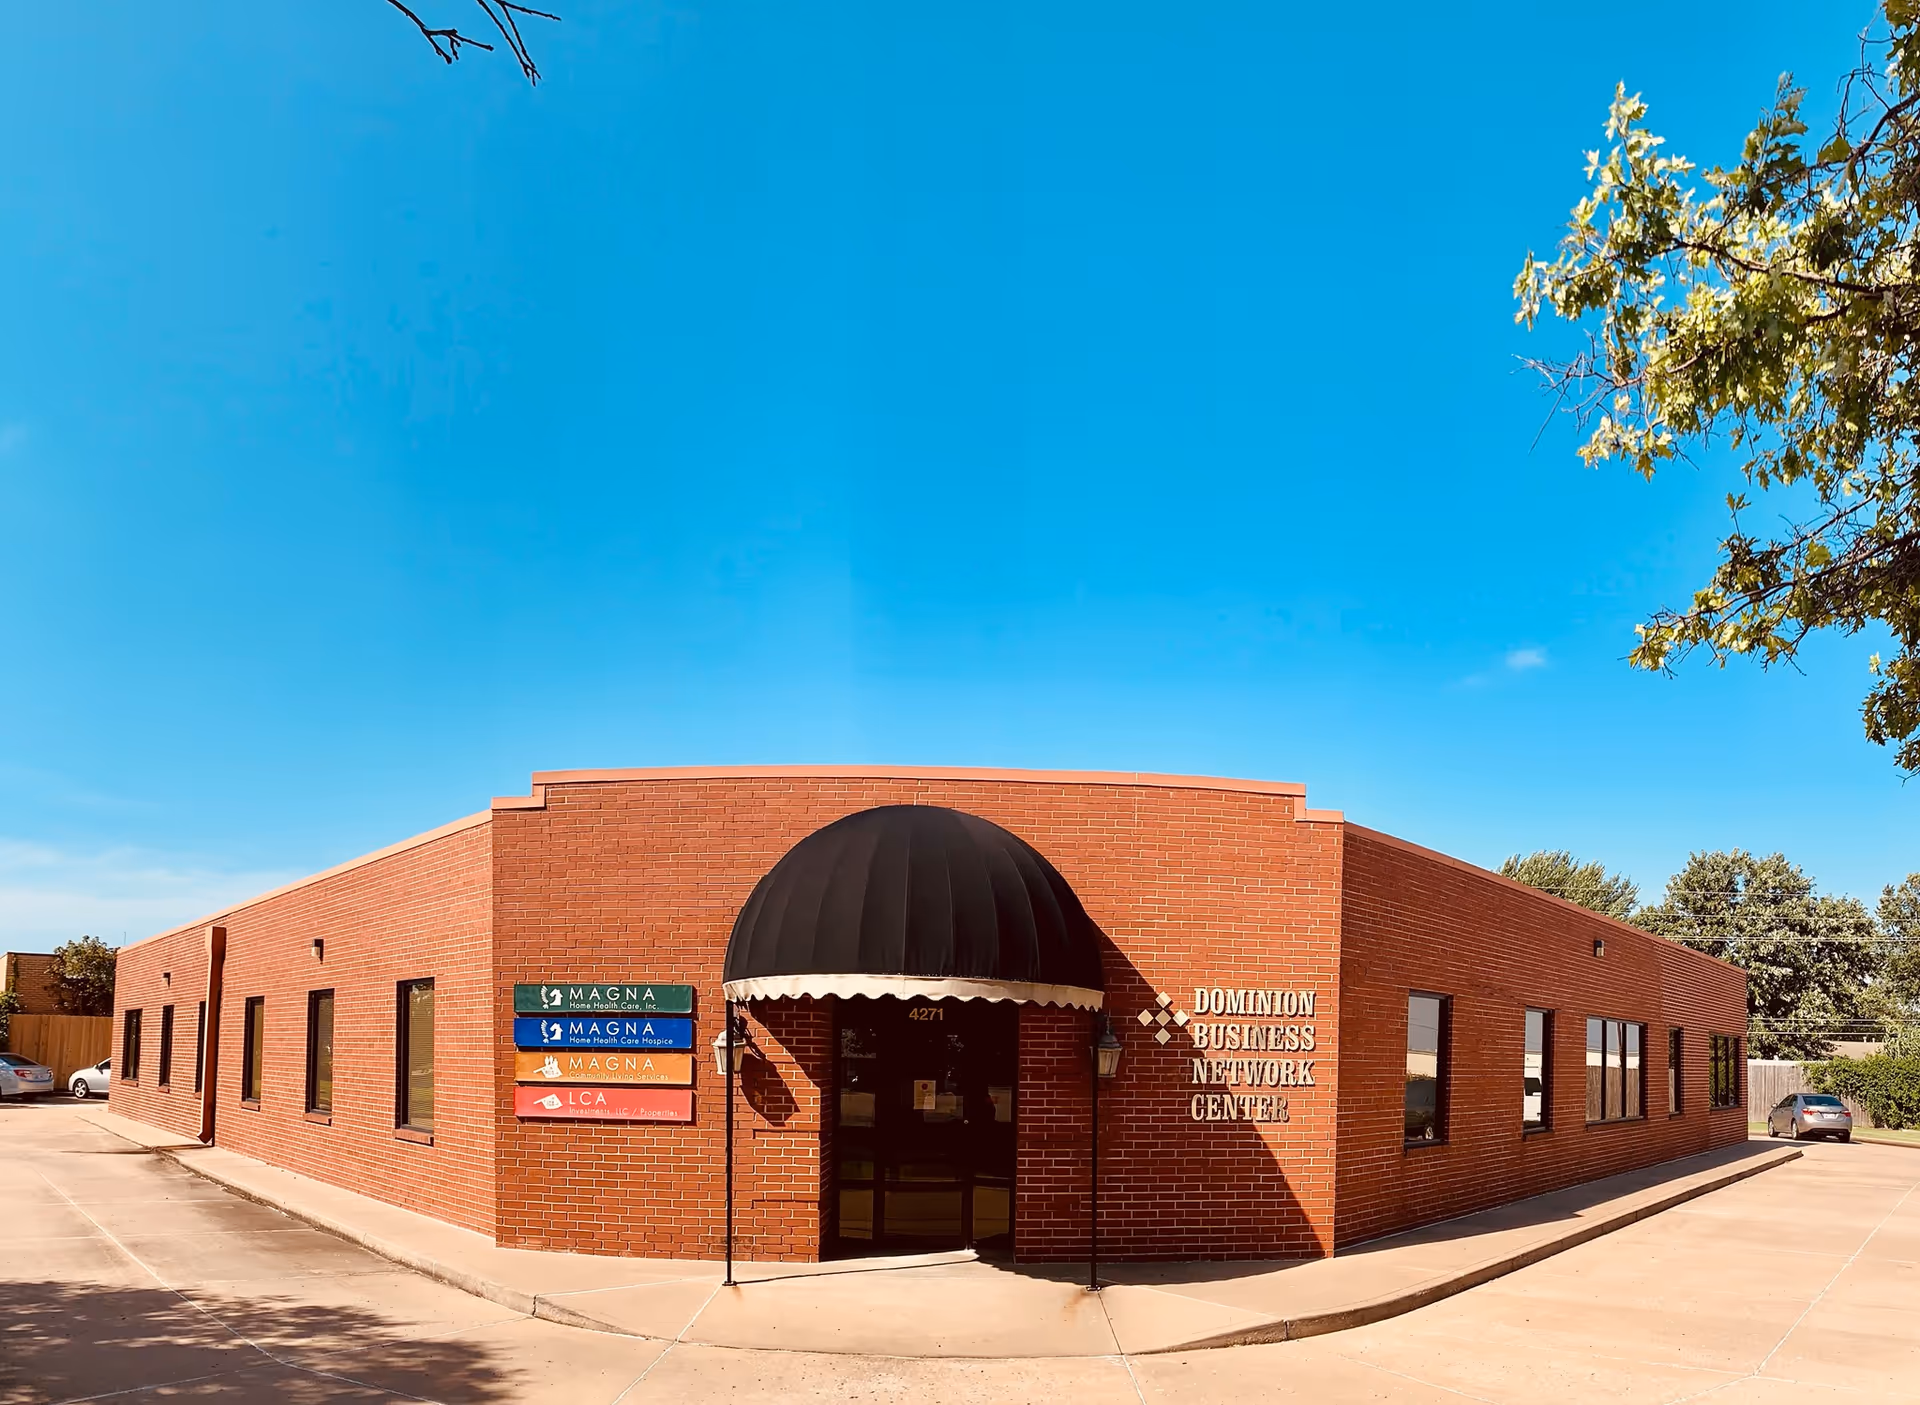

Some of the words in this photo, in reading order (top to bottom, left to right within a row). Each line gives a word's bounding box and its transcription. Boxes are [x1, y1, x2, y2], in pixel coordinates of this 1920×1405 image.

[569, 987, 655, 1001] MAGNA
[594, 1002, 618, 1010] Health
[620, 1002, 642, 1011] Care,
[1194, 988, 1315, 1016] DOMINION
[909, 1008, 944, 1020] 4271
[569, 1022, 655, 1035] MAGNA
[620, 1037, 639, 1045] Care
[642, 1037, 673, 1046] Hospice
[1193, 1023, 1315, 1051] BUSINESS
[569, 1057, 655, 1070] MAGNA
[569, 1072, 609, 1080] Community
[612, 1072, 634, 1081] Living
[637, 1073, 669, 1081] Services
[1192, 1058, 1315, 1087] NETWORK
[569, 1092, 607, 1105] LCA
[615, 1108, 629, 1116] LLC
[640, 1108, 678, 1117] Properties
[1191, 1093, 1289, 1122] CENTER
